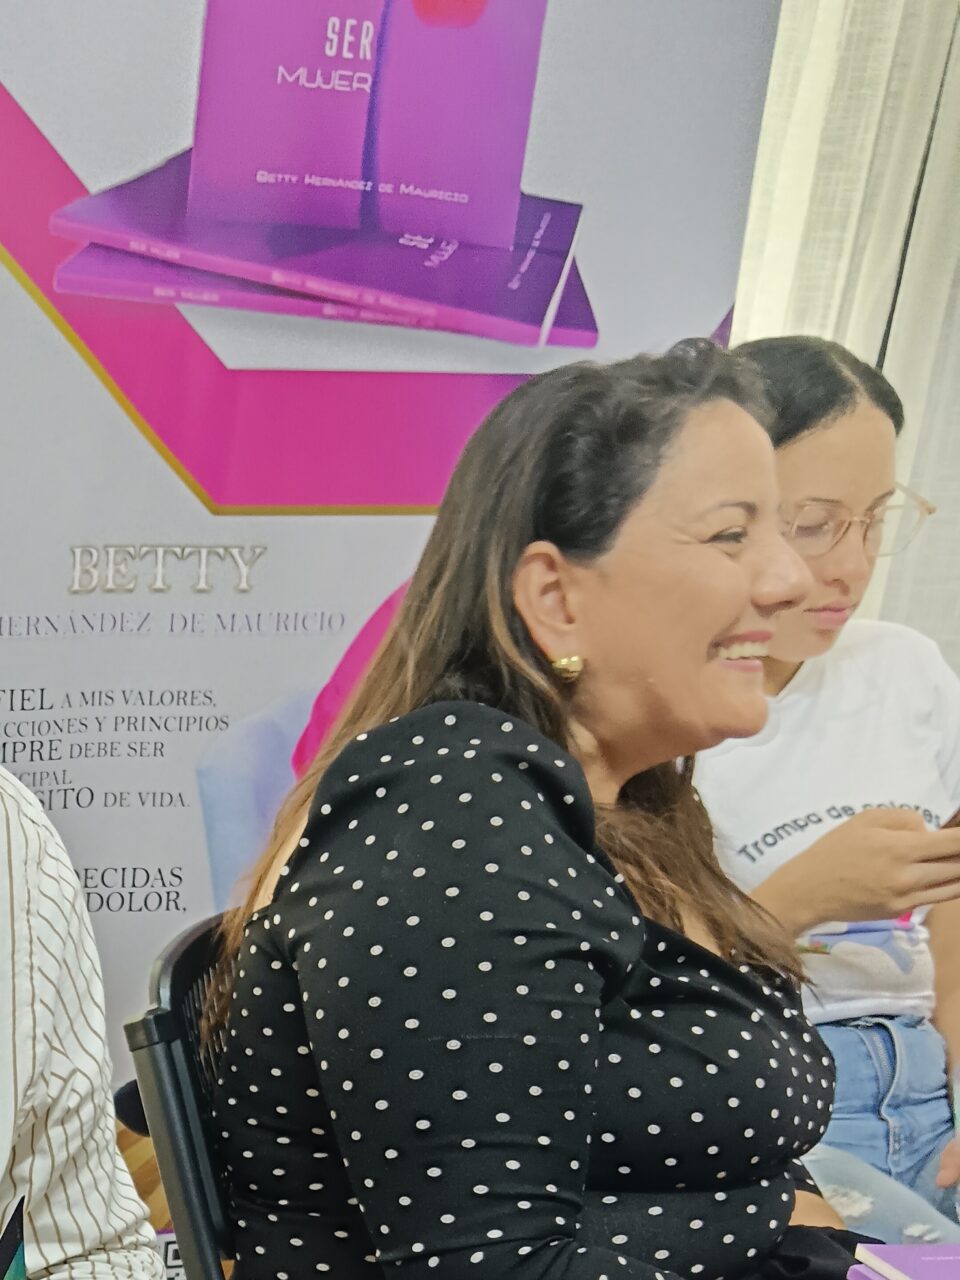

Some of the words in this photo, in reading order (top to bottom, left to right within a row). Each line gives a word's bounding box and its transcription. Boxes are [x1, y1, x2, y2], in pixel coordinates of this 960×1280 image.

[324, 16, 375, 61] SER
[277, 65, 374, 93] MUJER
[68, 544, 267, 595] BETTY
[168, 613, 205, 633] DE
[215, 610, 347, 633] MAURICIO
[61, 692, 73, 708] A
[80, 690, 115, 708] MIS
[122, 689, 217, 708] VALORES,
[95, 716, 108, 733] Y
[114, 715, 230, 733] PRINCIPIOS
[69, 742, 121, 759] DEBE
[127, 741, 165, 758] SER
[103, 792, 130, 808] DE
[138, 791, 191, 808] VIDA.
[737, 812, 823, 864] Trompa
[826, 805, 856, 820] de
[86, 890, 187, 913] DOLOR,
